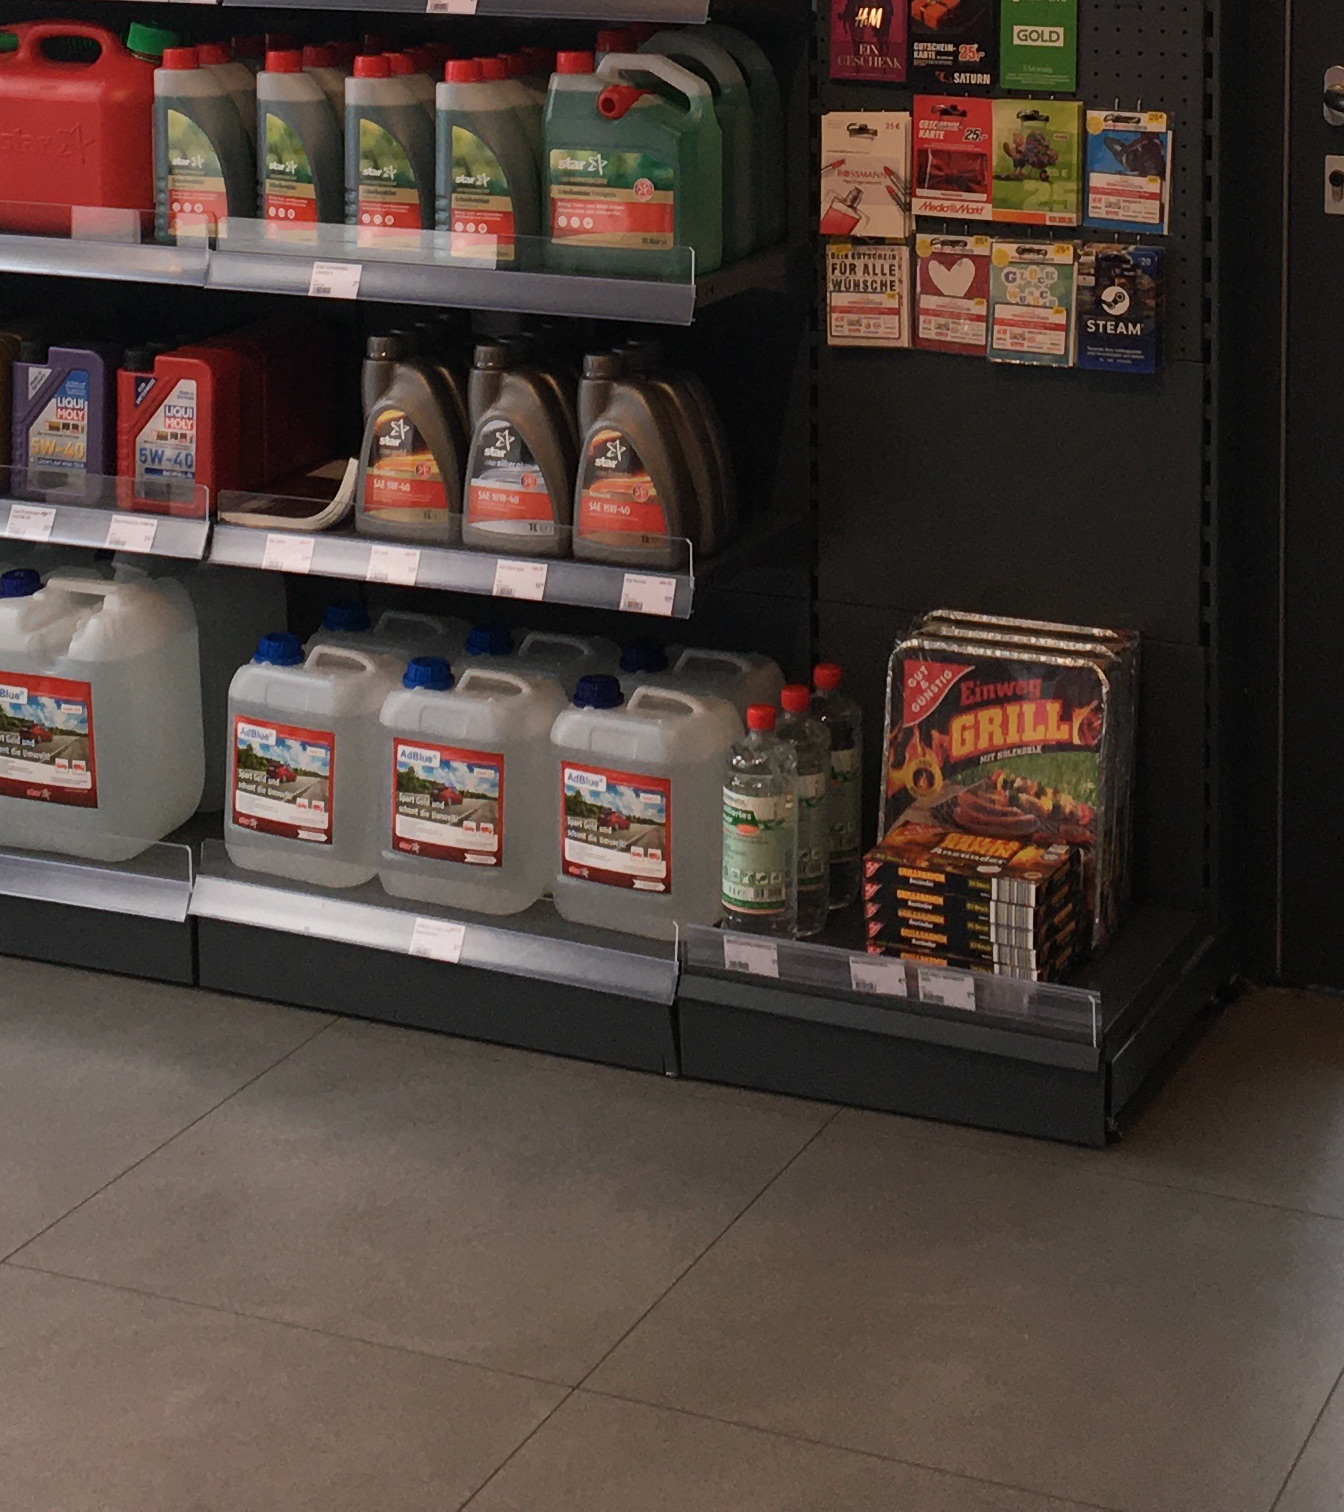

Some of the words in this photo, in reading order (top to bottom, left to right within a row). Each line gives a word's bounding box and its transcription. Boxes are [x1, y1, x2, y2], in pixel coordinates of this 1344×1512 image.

[1017, 29, 1060, 42] GOLD
[859, 44, 879, 54] EIN
[837, 57, 901, 69] GESCHENK
[954, 73, 990, 84] SATURN
[172, 157, 190, 166] star
[559, 157, 586, 170] star
[363, 168, 382, 177] star
[456, 176, 475, 185] star
[831, 262, 857, 275] FÜR
[863, 264, 896, 276] ALLE
[831, 277, 896, 291] WÜNSCHE
[1087, 320, 1141, 335] STEAM
[58, 397, 84, 408] LIQUI
[58, 409, 85, 420] MOLY
[165, 407, 193, 418] LIQUI
[165, 418, 193, 430] MOLY
[379, 436, 401, 446] star
[29, 440, 85, 459] 5W-40
[484, 447, 506, 457] star
[140, 448, 193, 469] 5W-40
[595, 457, 617, 468] star
[478, 491, 491, 500] SAE
[588, 502, 603, 511] SAE
[908, 665, 929, 687] GUT
[961, 679, 1042, 705] Einweg
[240, 727, 269, 741] AdBlue
[951, 700, 1071, 757] GRILL
[7, 735, 21, 745] Geld
[401, 750, 433, 764] AdBlue
[567, 773, 599, 788] AdBlue
